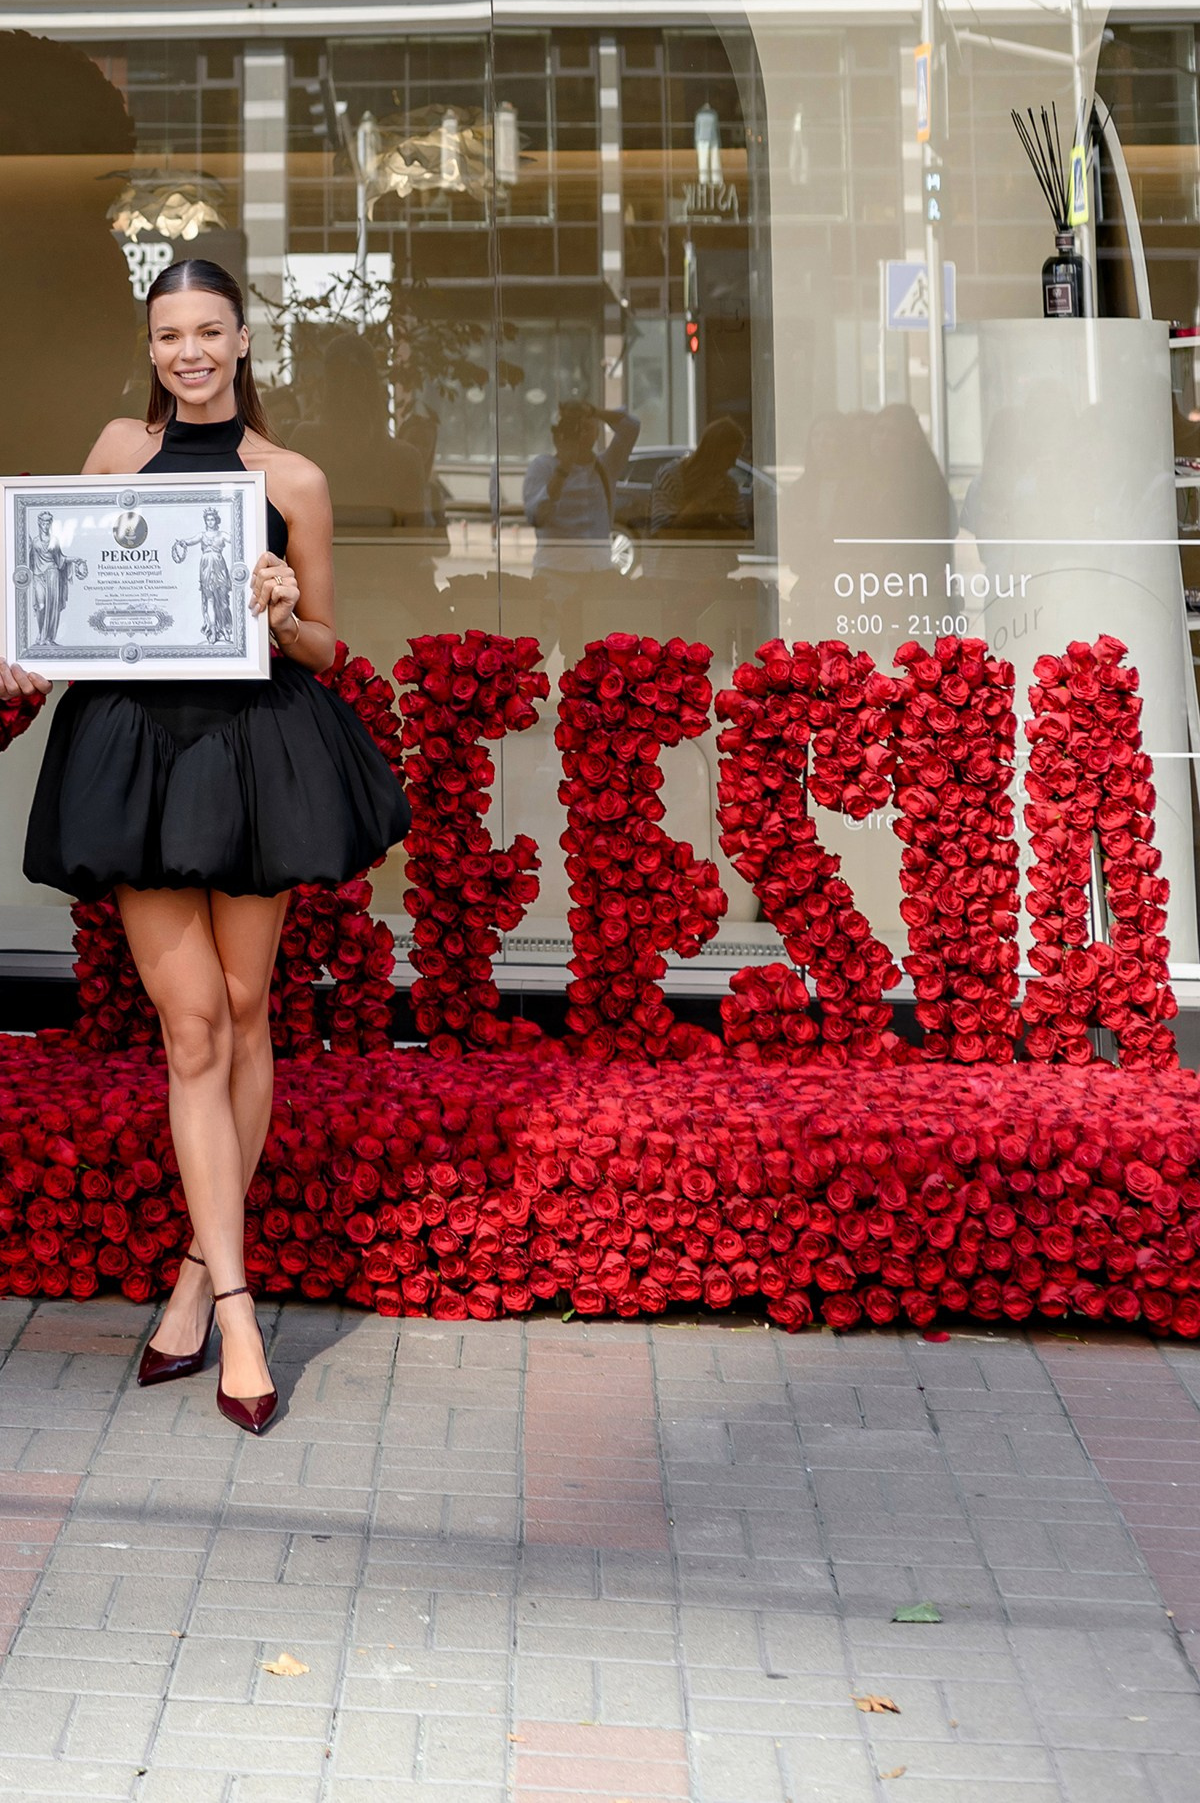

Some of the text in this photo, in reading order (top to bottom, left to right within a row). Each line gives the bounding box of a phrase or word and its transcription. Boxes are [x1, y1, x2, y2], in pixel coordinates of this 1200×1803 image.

[101, 549, 160, 564] РЕКОРД
[834, 563, 1032, 604] open hour
[836, 614, 883, 635] 8:00
[908, 614, 968, 636] 21:00
